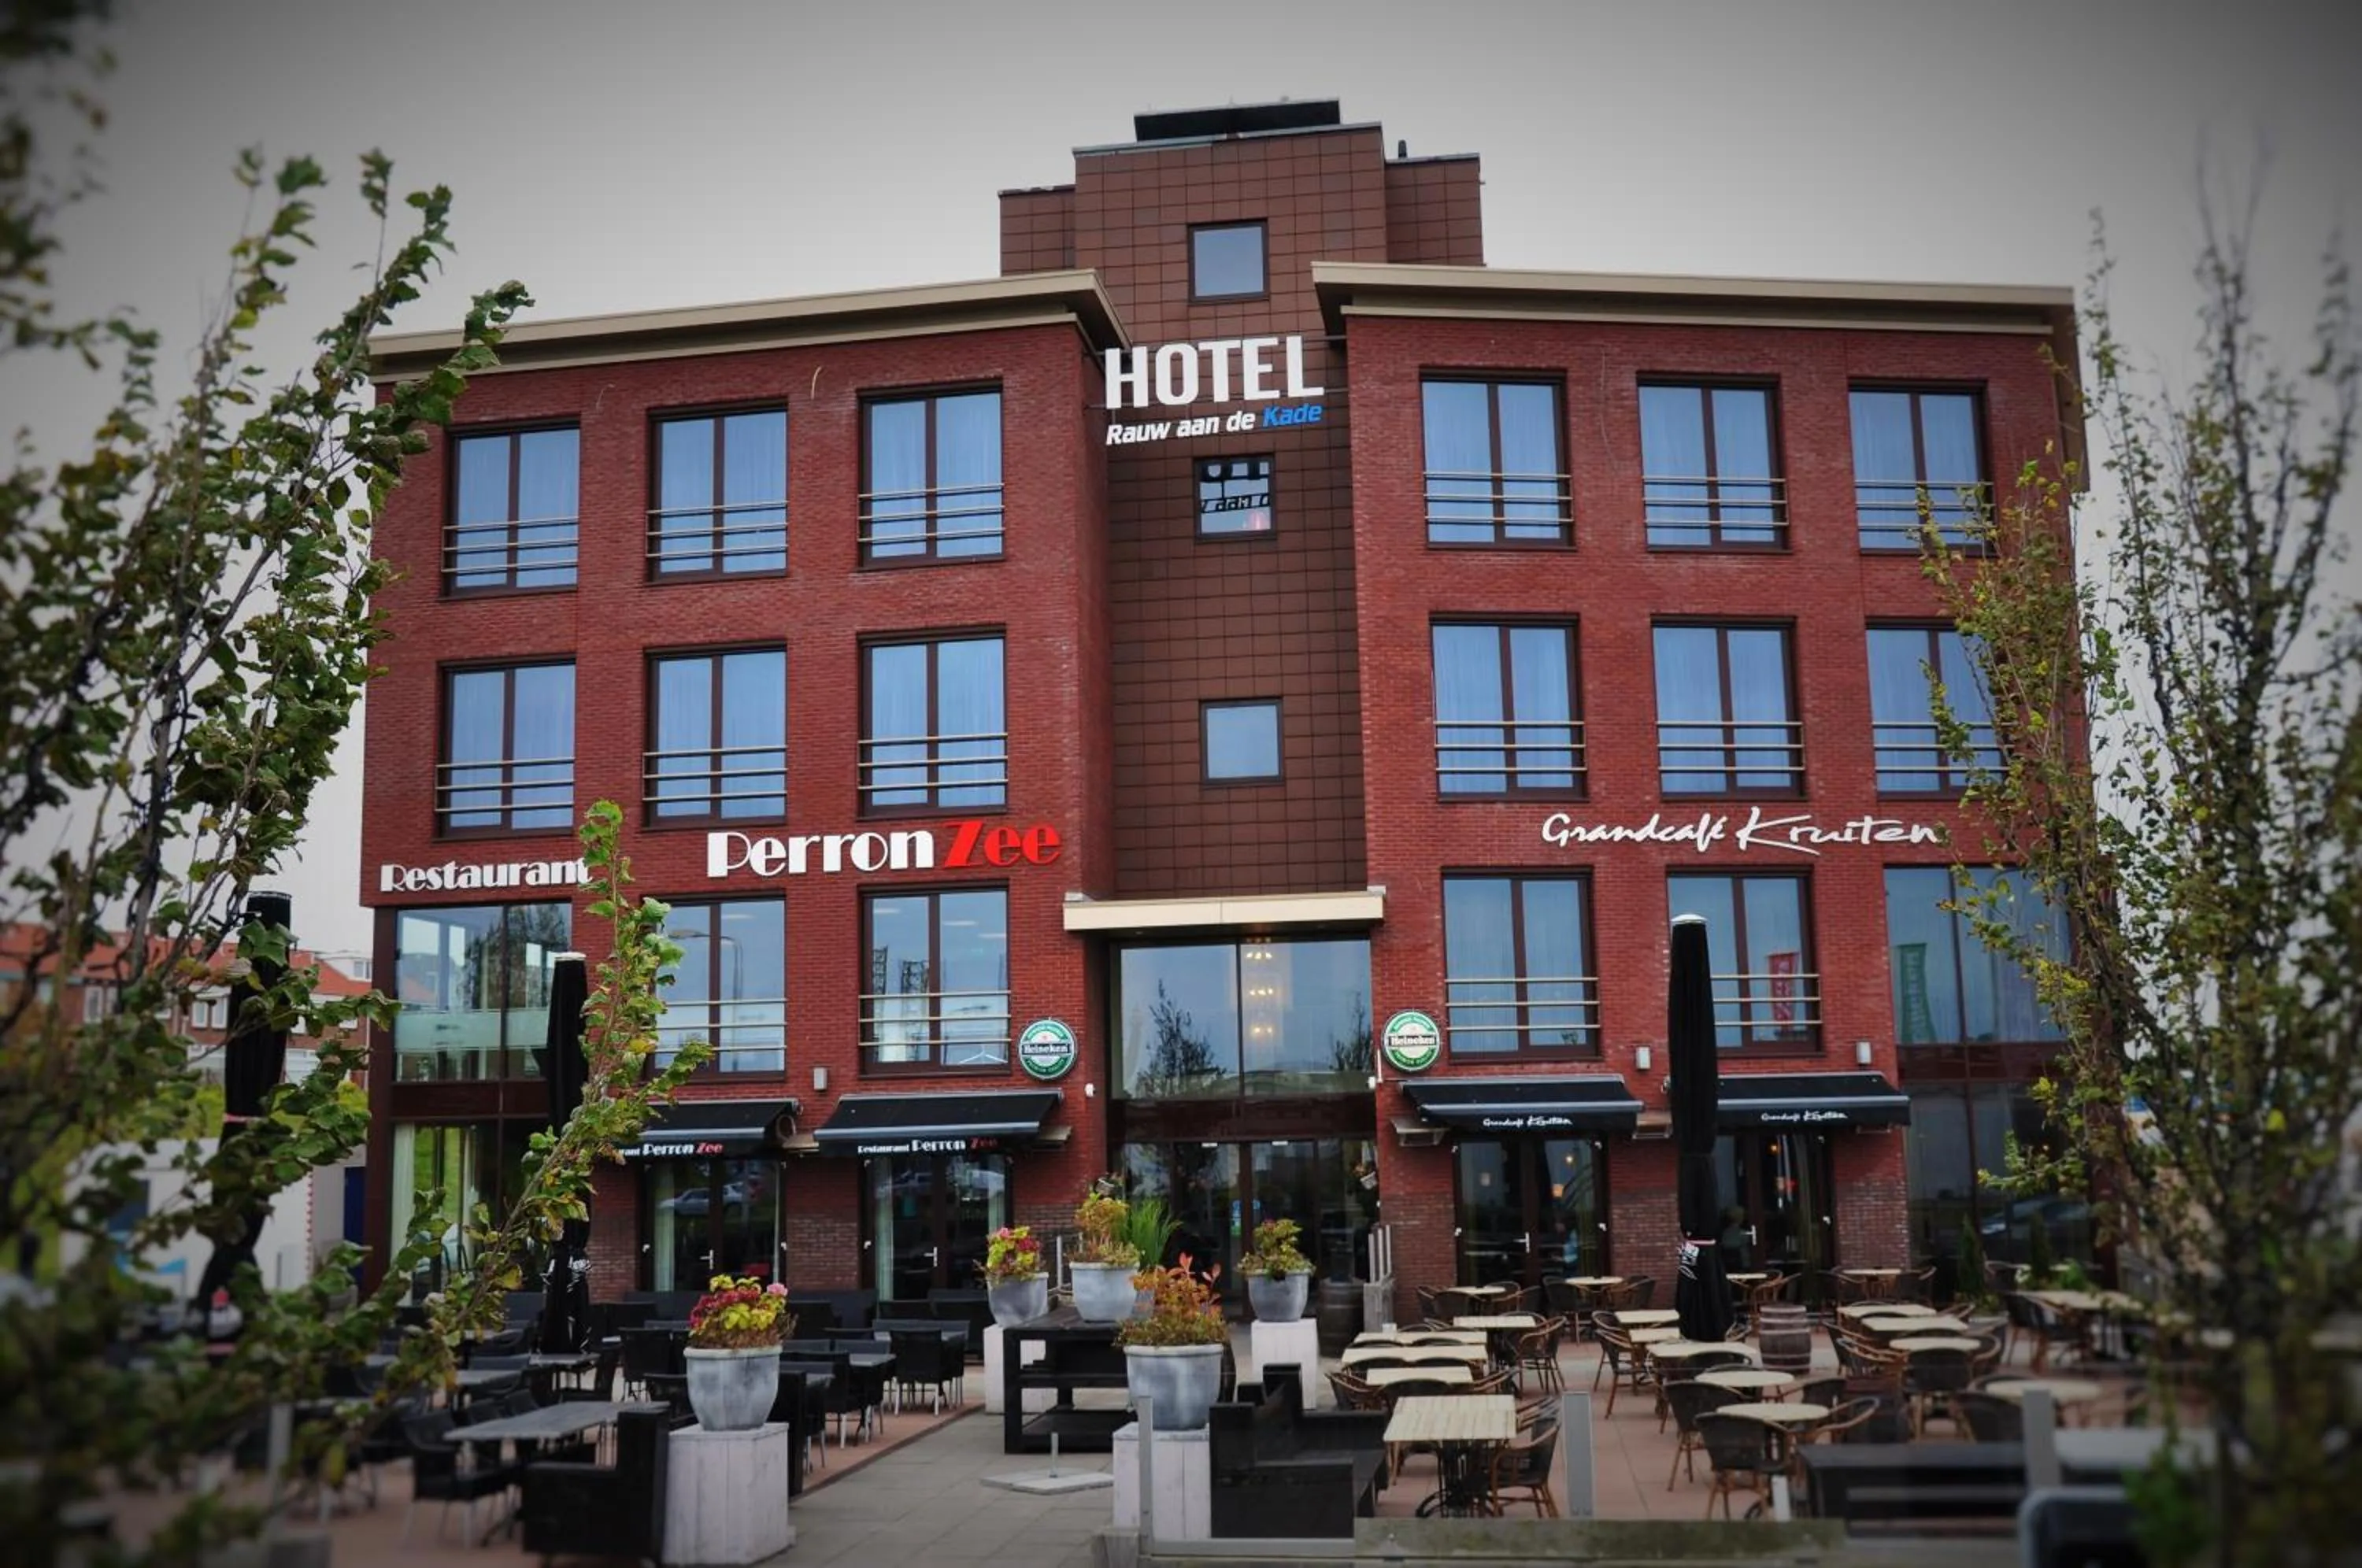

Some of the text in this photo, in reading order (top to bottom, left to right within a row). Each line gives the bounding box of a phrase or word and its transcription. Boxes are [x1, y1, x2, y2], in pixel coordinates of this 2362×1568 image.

[1105, 335, 1325, 409] HOTEL
[1105, 403, 1324, 446] Rauw aan de Kade
[707, 819, 1061, 878] Perron Zee
[1542, 806, 1940, 856] Grandcafé Kruiten
[380, 856, 594, 893] Restaurant
[642, 1143, 694, 1156] Perron
[695, 1142, 724, 1155] Zee
[857, 1144, 910, 1154] Restaurant
[912, 1139, 966, 1152] Perron
